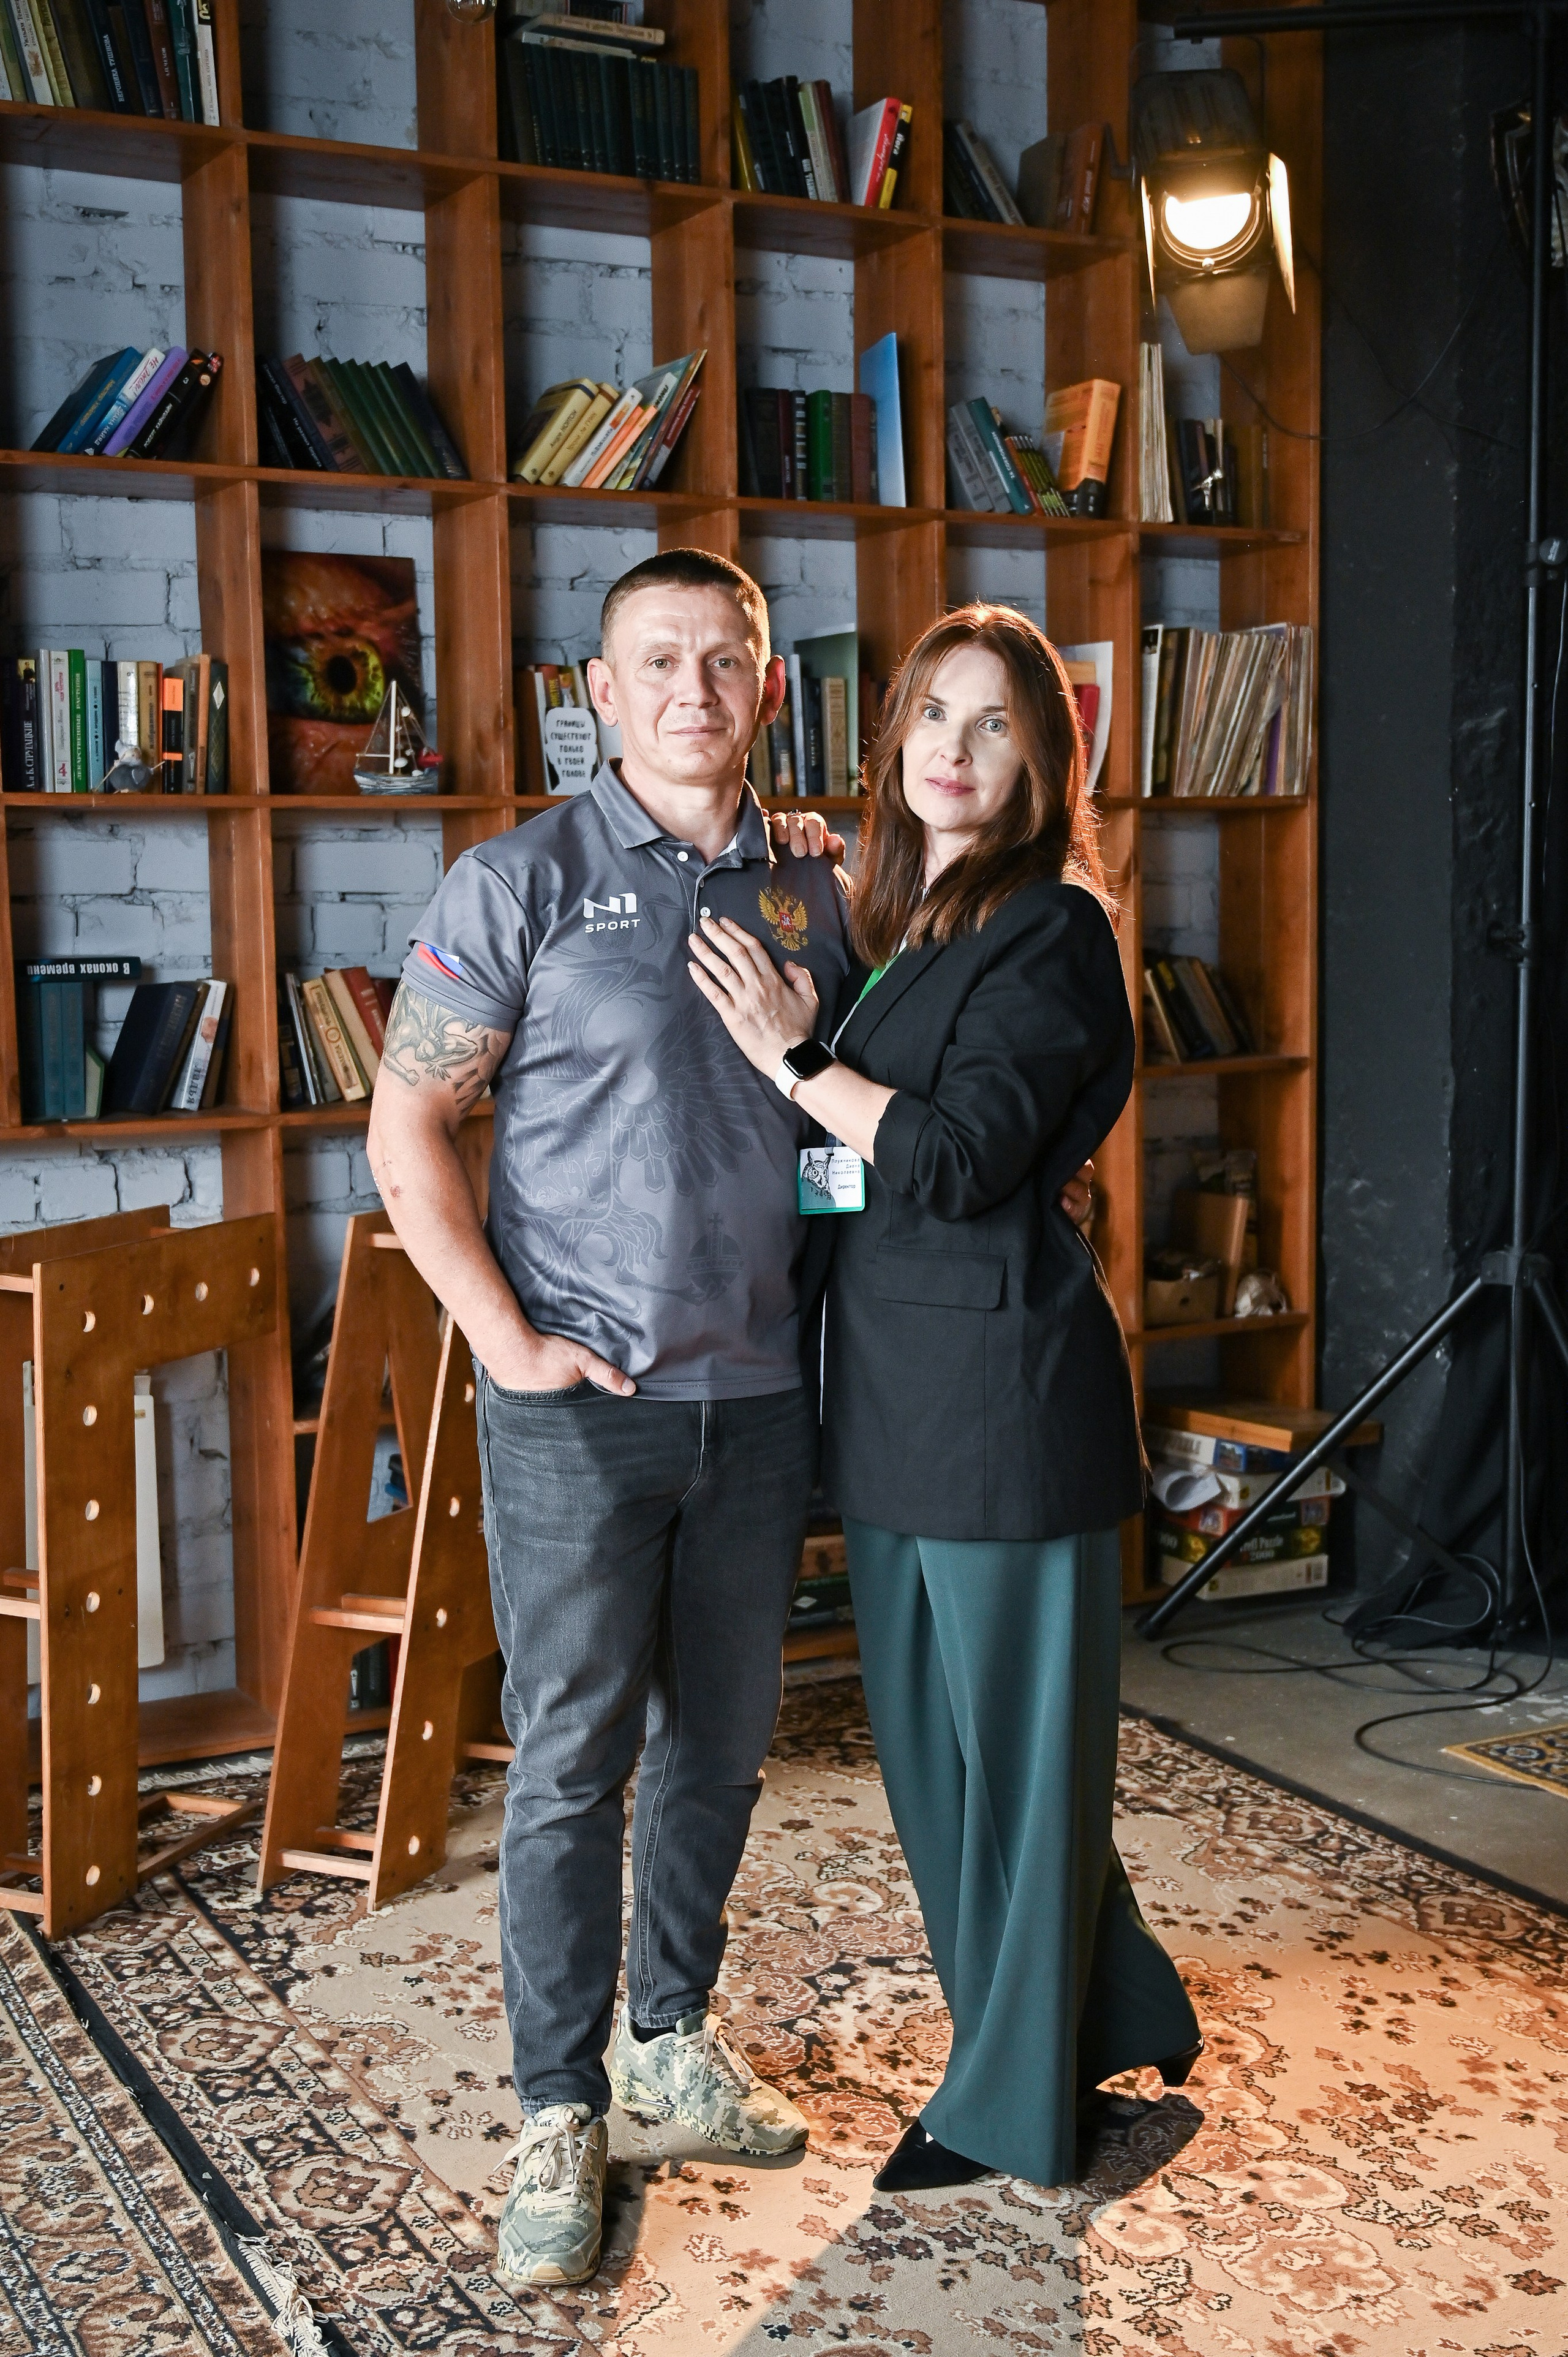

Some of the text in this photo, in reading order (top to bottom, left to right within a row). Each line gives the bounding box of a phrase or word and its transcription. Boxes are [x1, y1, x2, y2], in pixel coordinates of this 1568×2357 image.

[104, 35, 124, 102] ВЕРОНИКА ТУШНОВА
[95, 422, 111, 447] НАЙЯД
[556, 719, 586, 728] ГРАНИЦЫ
[24, 720, 34, 766] СТРУГАЦКИЕ
[550, 732, 592, 741] СУЩЕСТВУЮТ
[561, 770, 586, 778] ГОЛОВЕ
[585, 919, 641, 933] SPORT
[26, 963, 130, 975] В окопах времени
